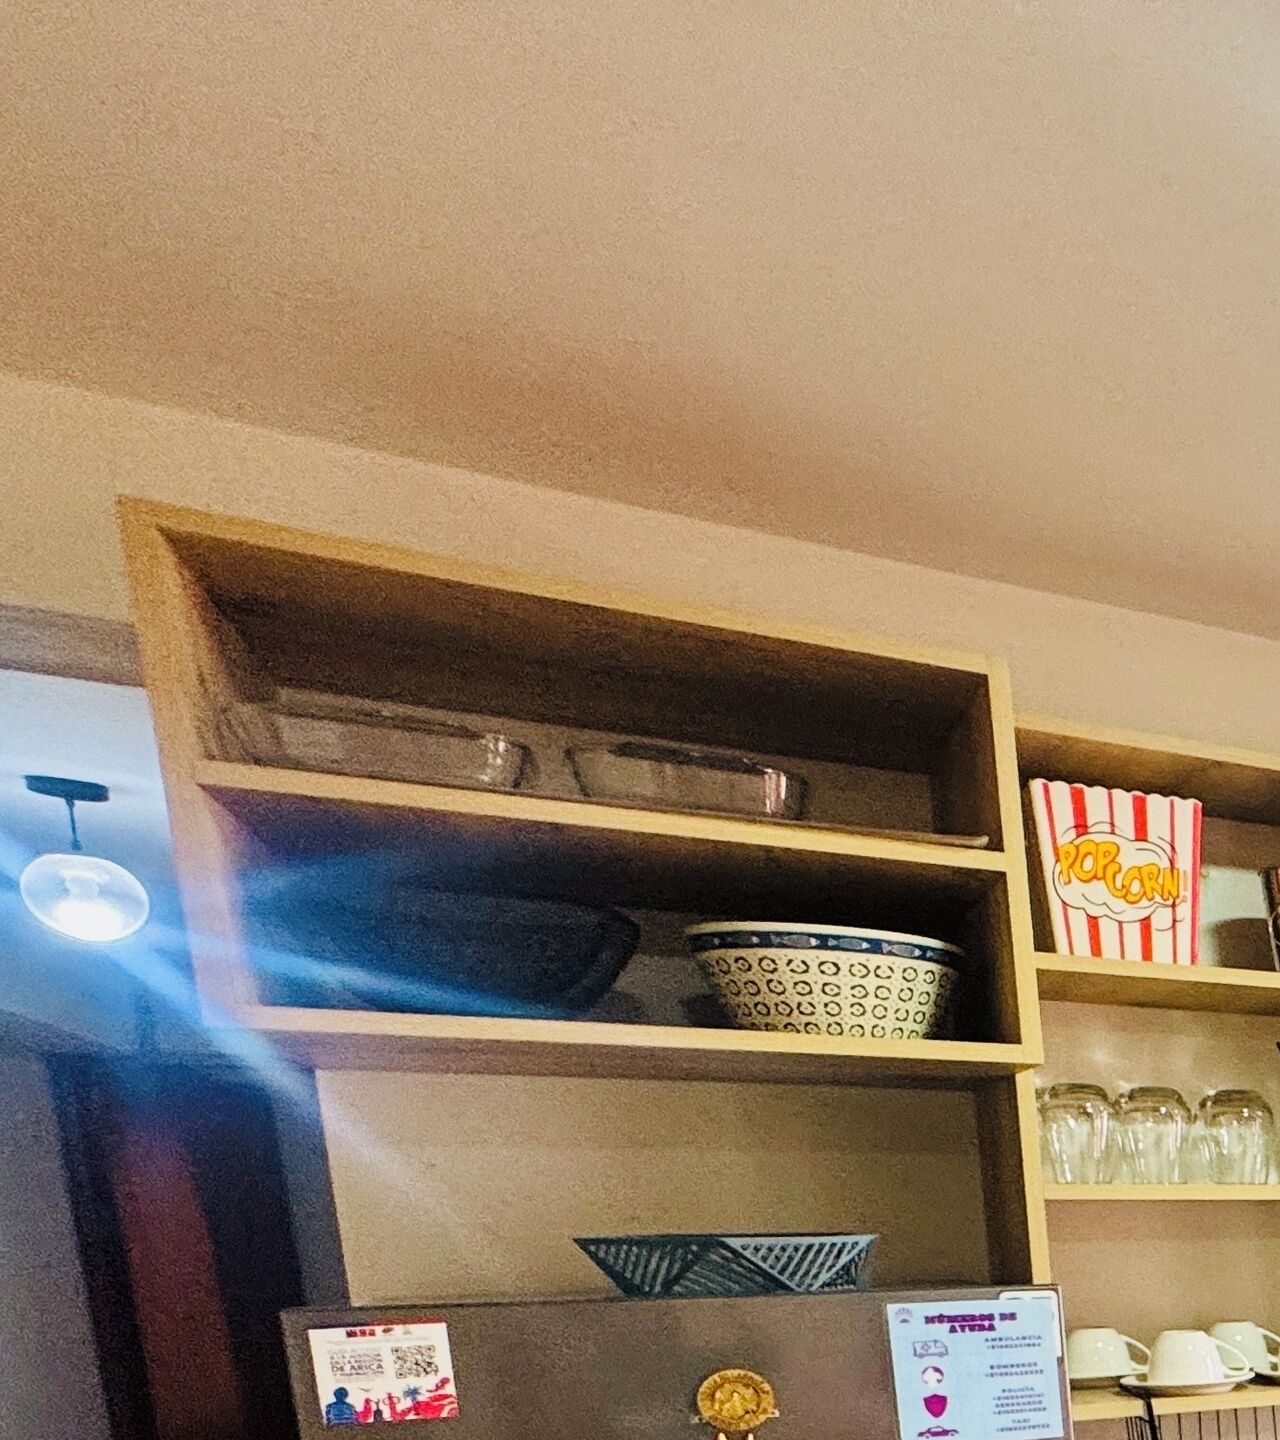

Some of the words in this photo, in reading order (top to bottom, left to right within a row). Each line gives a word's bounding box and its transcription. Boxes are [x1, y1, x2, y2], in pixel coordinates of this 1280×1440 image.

[999, 1312, 1018, 1322] DE
[948, 1323, 997, 1334] AYUDA
[984, 1335, 1042, 1343] AMBULANCIA
[331, 1365, 345, 1373] DE
[349, 1363, 384, 1372] ARICA
[989, 1362, 1038, 1371] BOMBEROS
